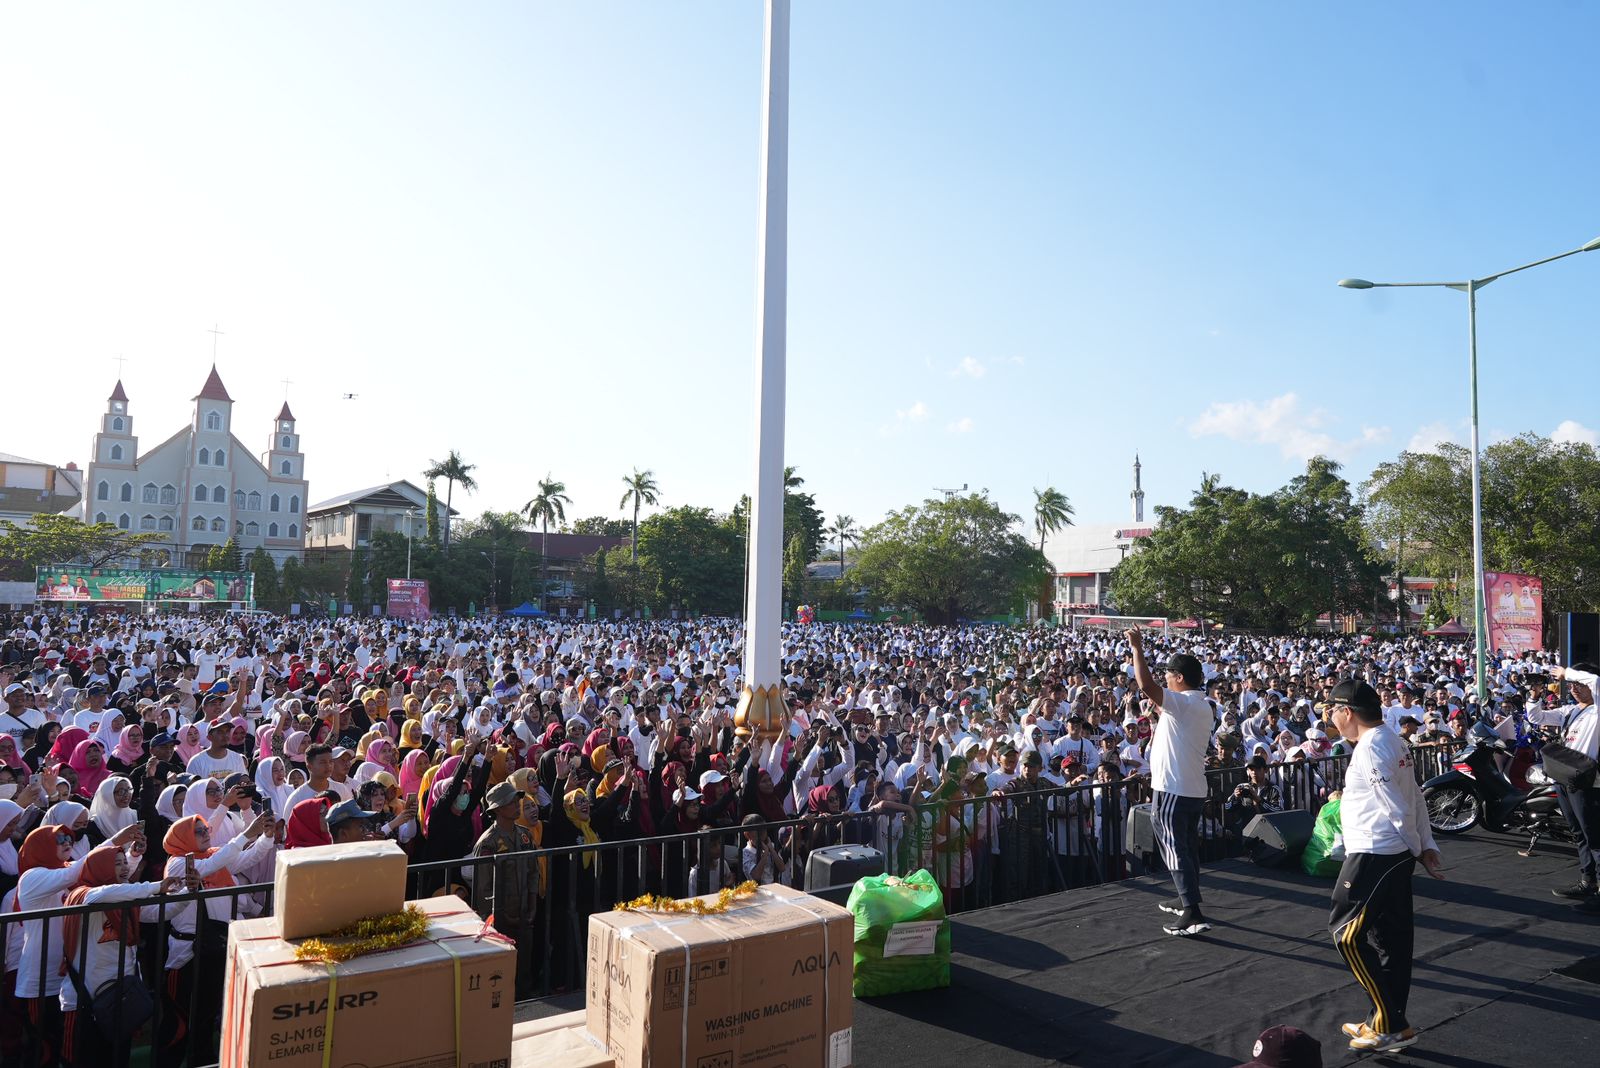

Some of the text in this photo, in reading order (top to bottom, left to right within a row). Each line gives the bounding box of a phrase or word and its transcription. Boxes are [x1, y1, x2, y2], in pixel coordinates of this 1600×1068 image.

[792, 951, 841, 976] AQUA
[272, 990, 378, 1020] SHARP
[704, 995, 813, 1033] WASHING MACHINE
[268, 1043, 314, 1060] LEMARI
